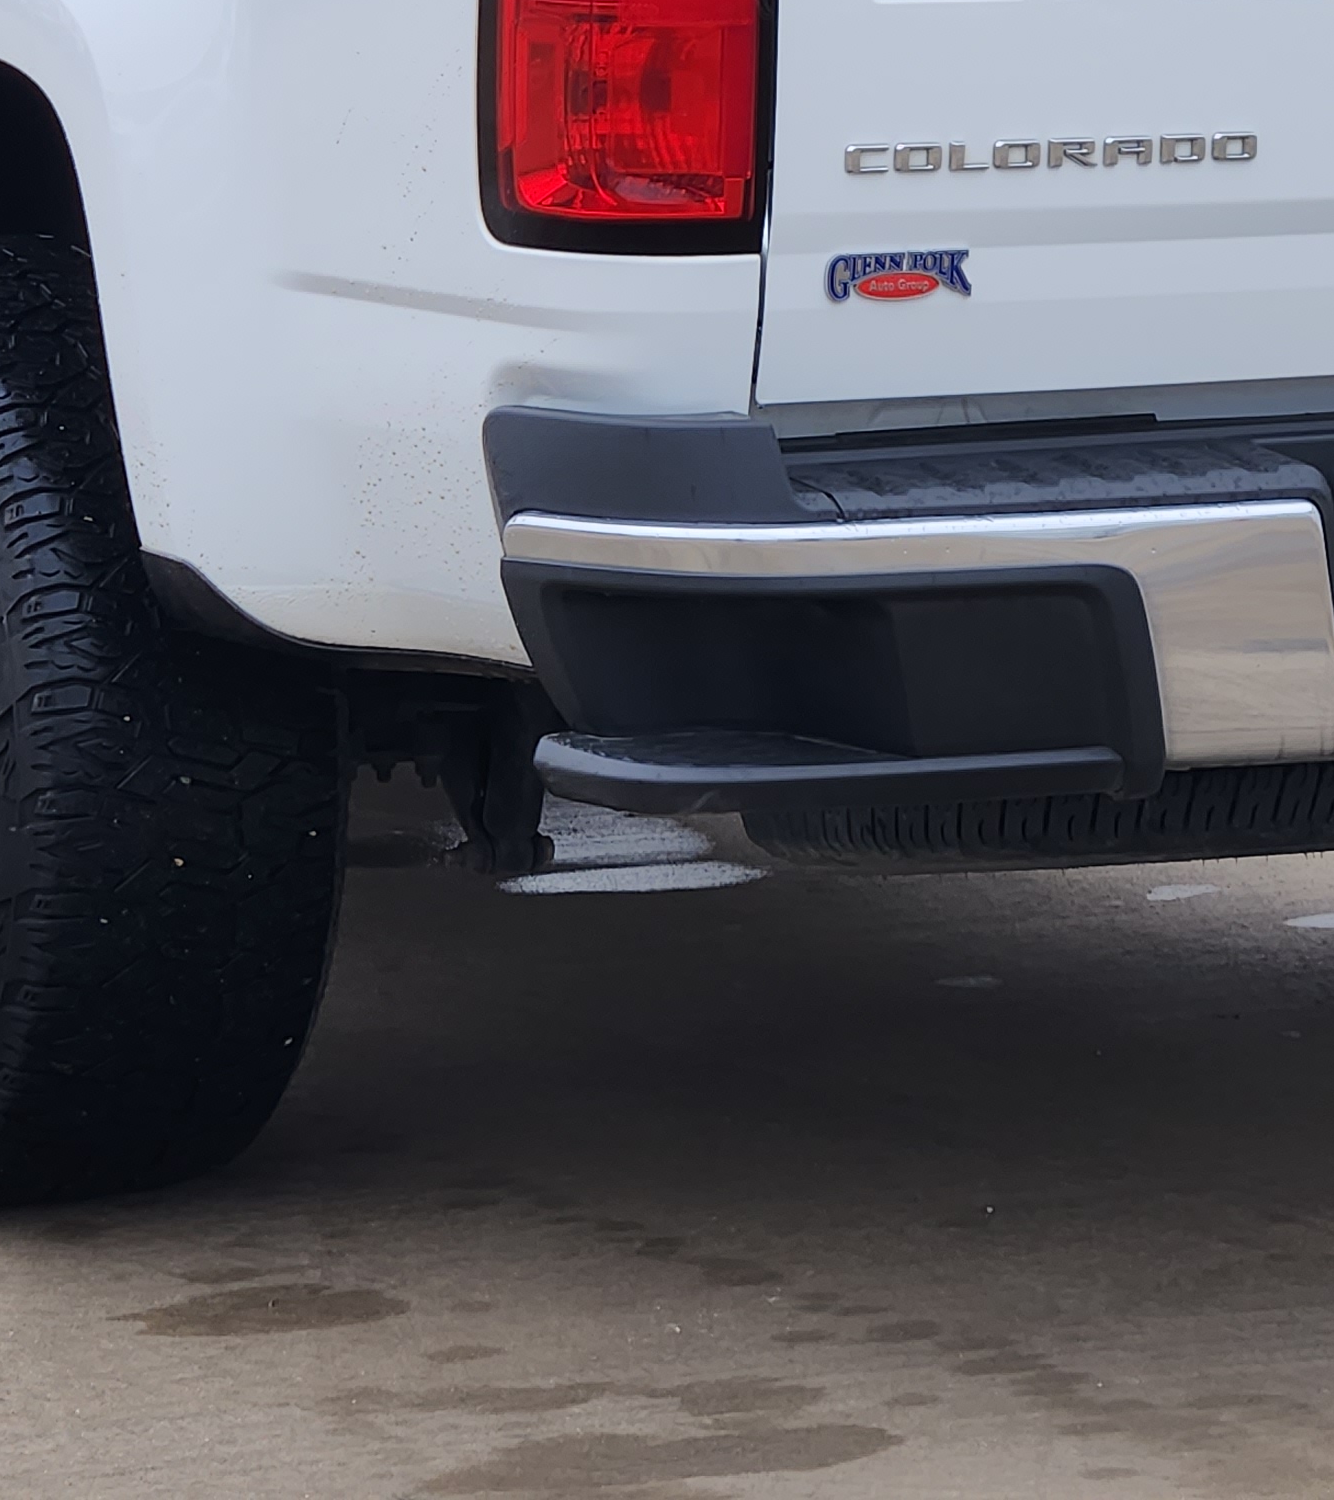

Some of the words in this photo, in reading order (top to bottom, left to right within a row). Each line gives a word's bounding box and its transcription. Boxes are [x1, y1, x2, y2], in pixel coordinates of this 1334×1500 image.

[844, 130, 1258, 174] COLORADO
[824, 253, 906, 301] GLENN
[907, 250, 972, 296] POLK
[869, 280, 895, 292] Auto
[898, 278, 929, 293] Group
